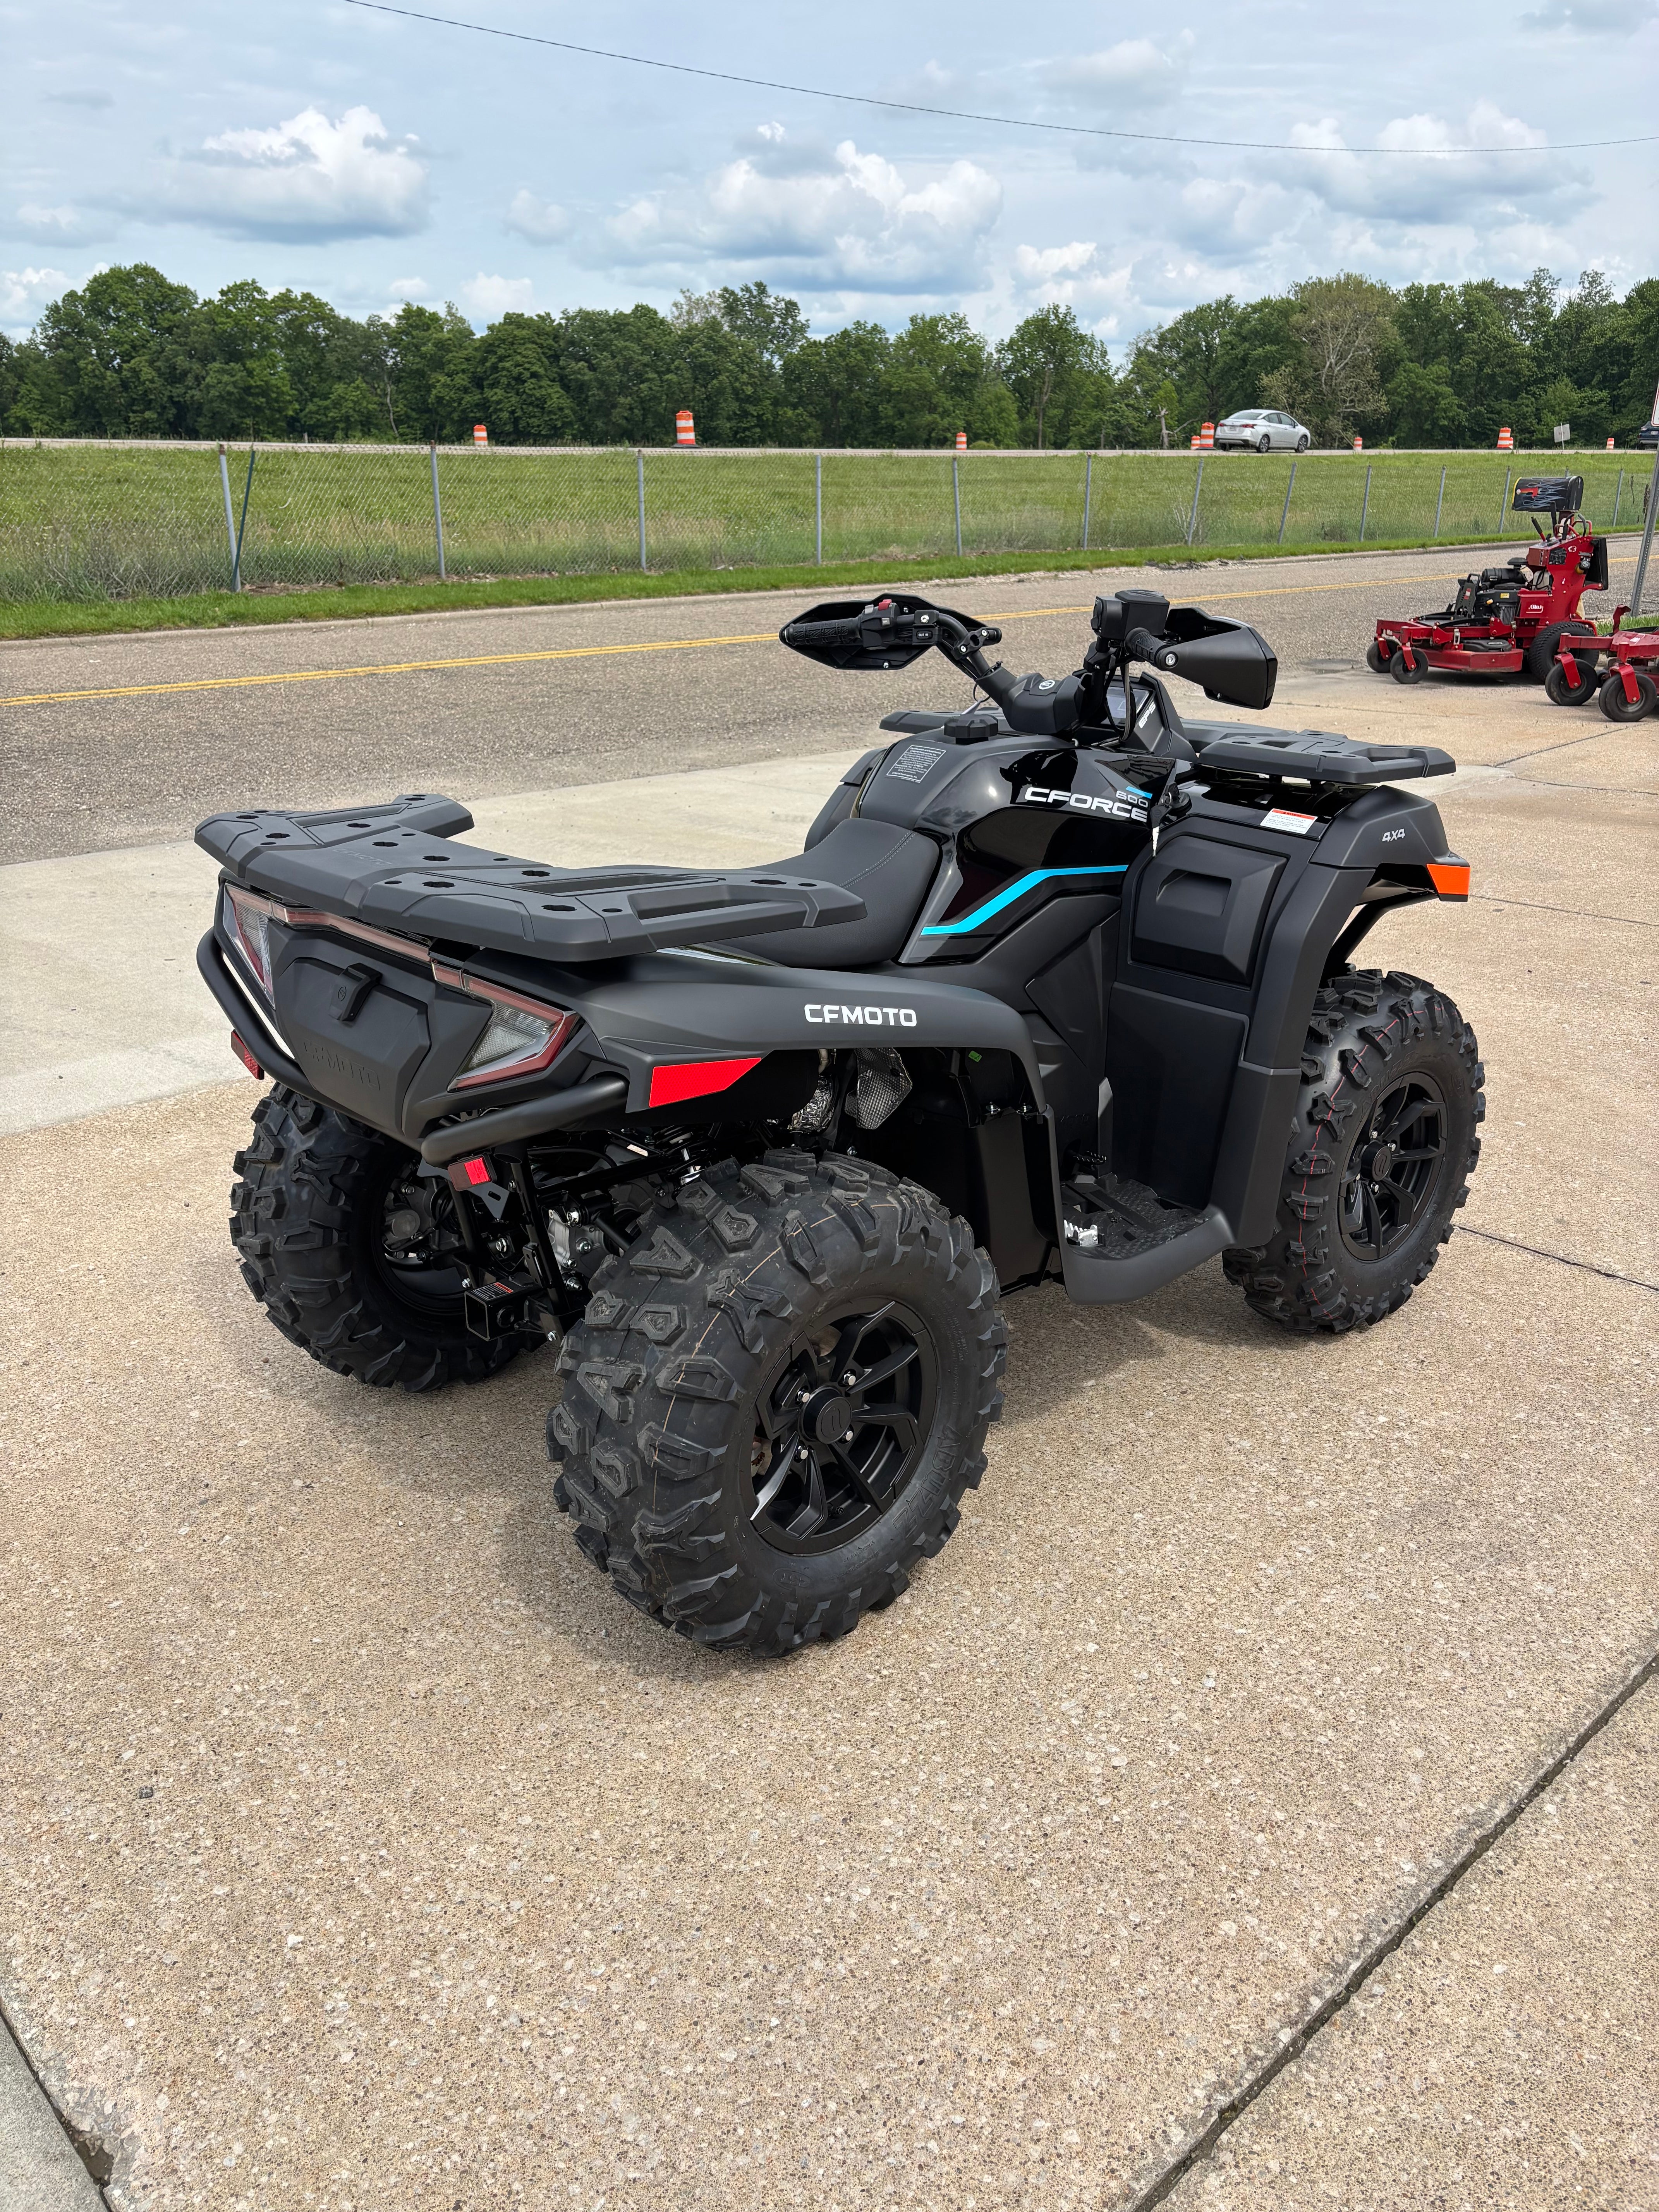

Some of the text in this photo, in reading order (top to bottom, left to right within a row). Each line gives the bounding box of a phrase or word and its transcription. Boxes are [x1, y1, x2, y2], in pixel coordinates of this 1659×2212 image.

[1139, 701, 1156, 728] EPS
[1024, 787, 1148, 823] CFORCE
[1116, 790, 1149, 808] 600
[804, 1004, 917, 1027] CFMOTO
[892, 1424, 967, 1539] ABUZZ
